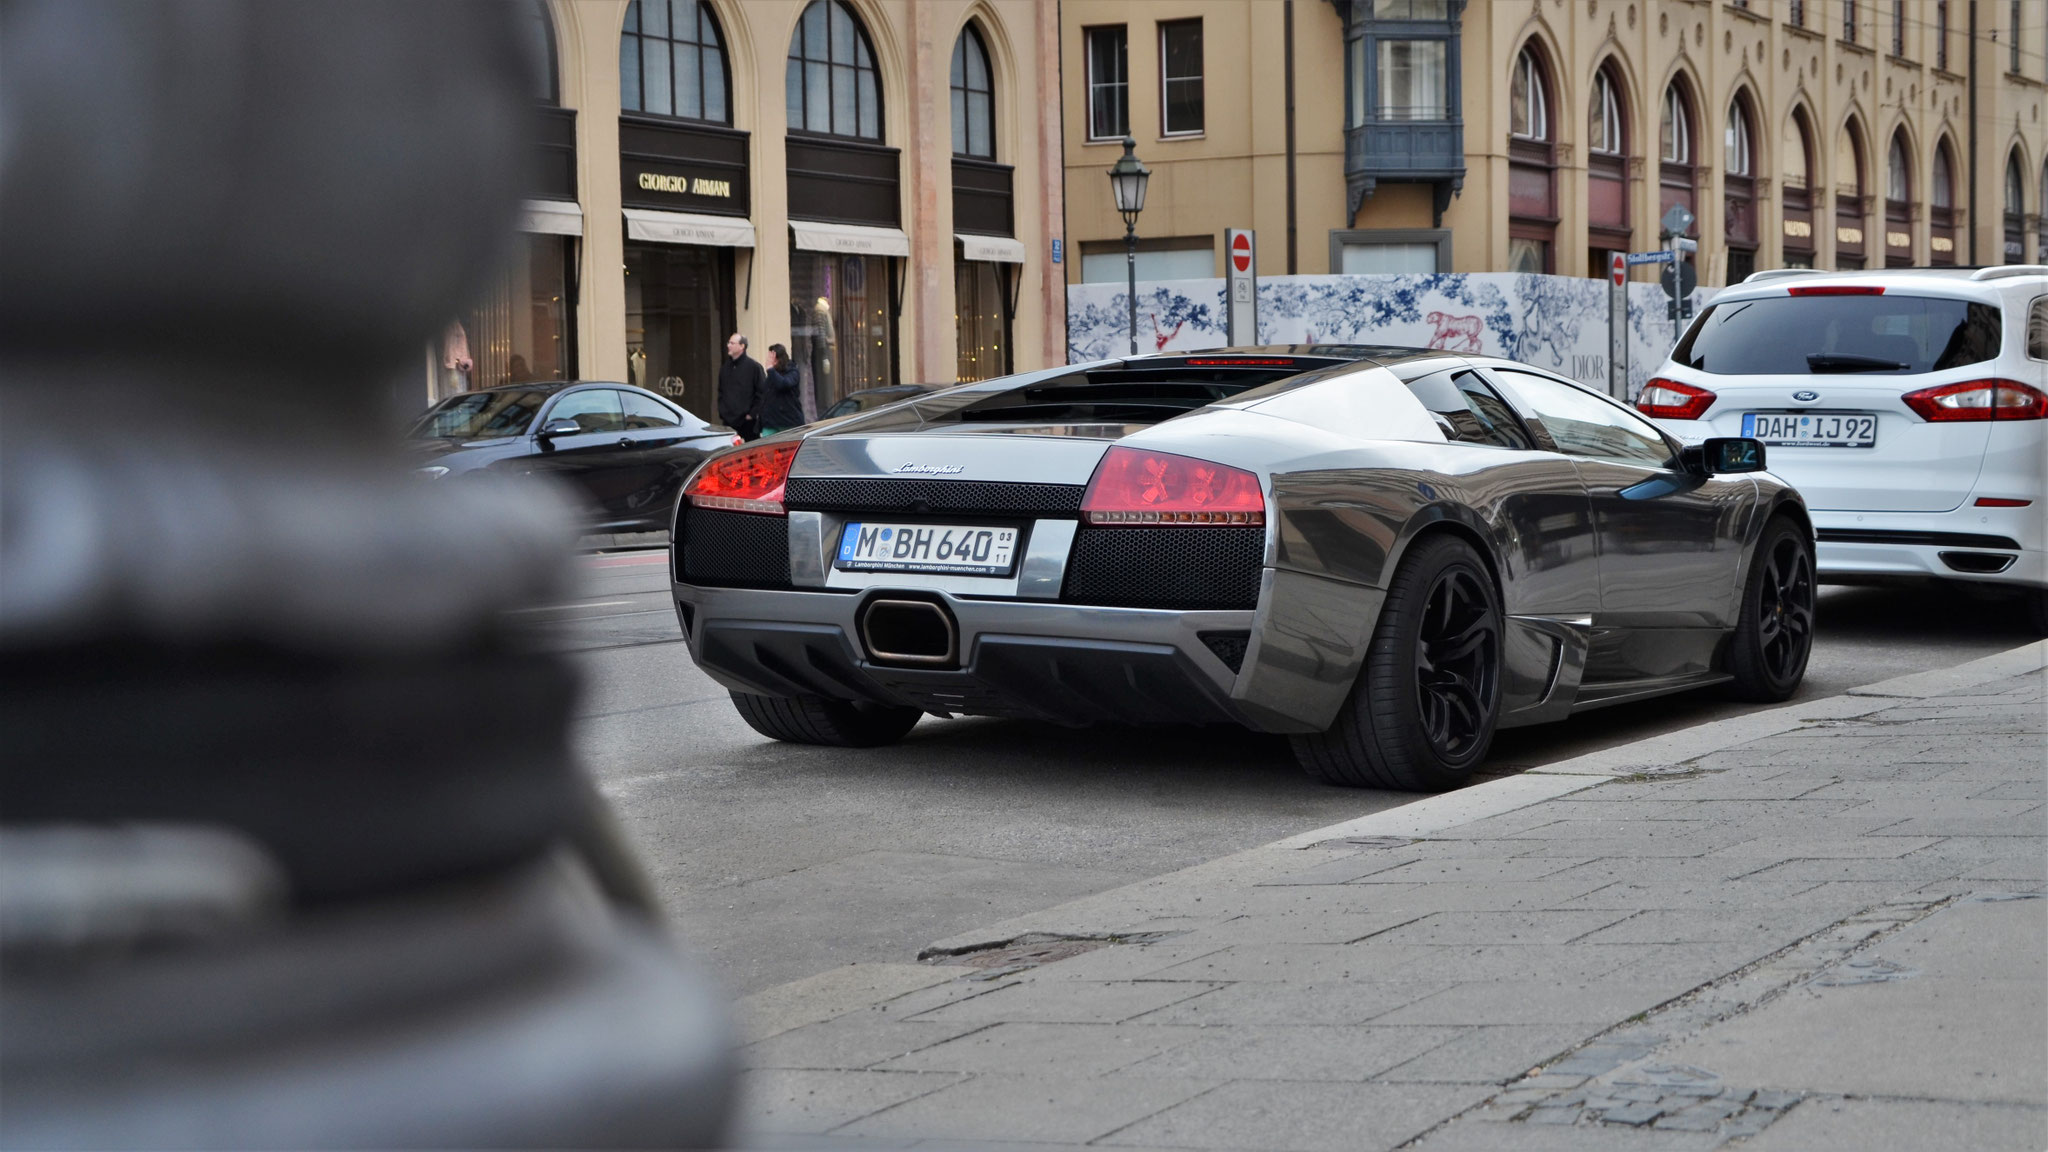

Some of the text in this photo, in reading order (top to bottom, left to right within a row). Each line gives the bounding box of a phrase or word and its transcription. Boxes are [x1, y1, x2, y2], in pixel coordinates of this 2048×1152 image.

[639, 173, 730, 197] GIORGIO ARMANI
[1784, 220, 1811, 237] VALENTINO
[1572, 355, 1605, 380] DIOR
[1797, 391, 1814, 400] Ford
[1755, 417, 1798, 438] DAH
[1845, 418, 1873, 439] 92
[892, 461, 965, 476] Lamborghini
[855, 527, 993, 562] M BH 640
[999, 532, 1012, 541] 03
[843, 545, 851, 555] D
[854, 561, 987, 573] Lamborghini München www.lamborghini-muenchen.com
